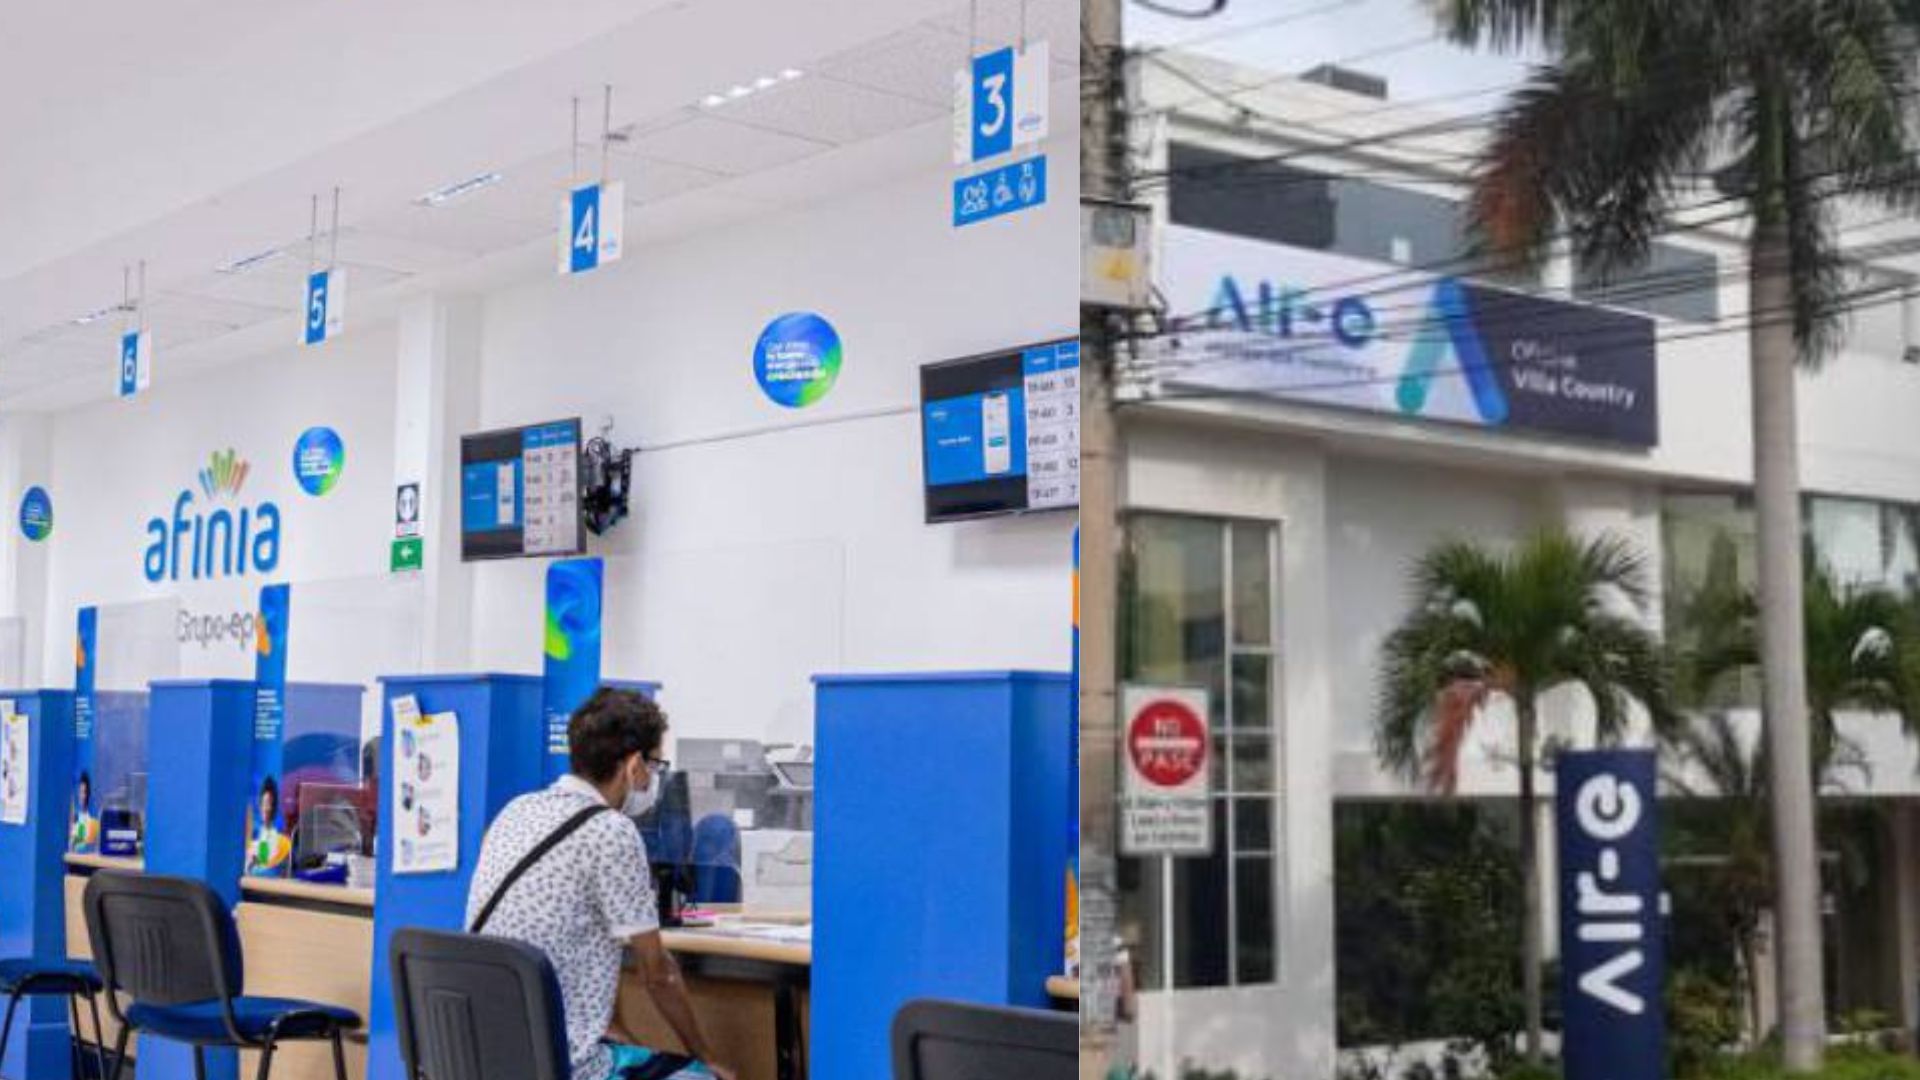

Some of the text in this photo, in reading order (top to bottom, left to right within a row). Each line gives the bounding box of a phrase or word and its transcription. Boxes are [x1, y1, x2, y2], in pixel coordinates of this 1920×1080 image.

[980, 73, 1006, 137] 3
[574, 204, 594, 253] 4
[310, 288, 325, 330] 5
[123, 348, 135, 382] 6
[1511, 367, 1636, 410] Villa Country
[144, 489, 281, 583] afinia
[175, 608, 256, 650] Grupo-ep
[1154, 717, 1182, 738] NO
